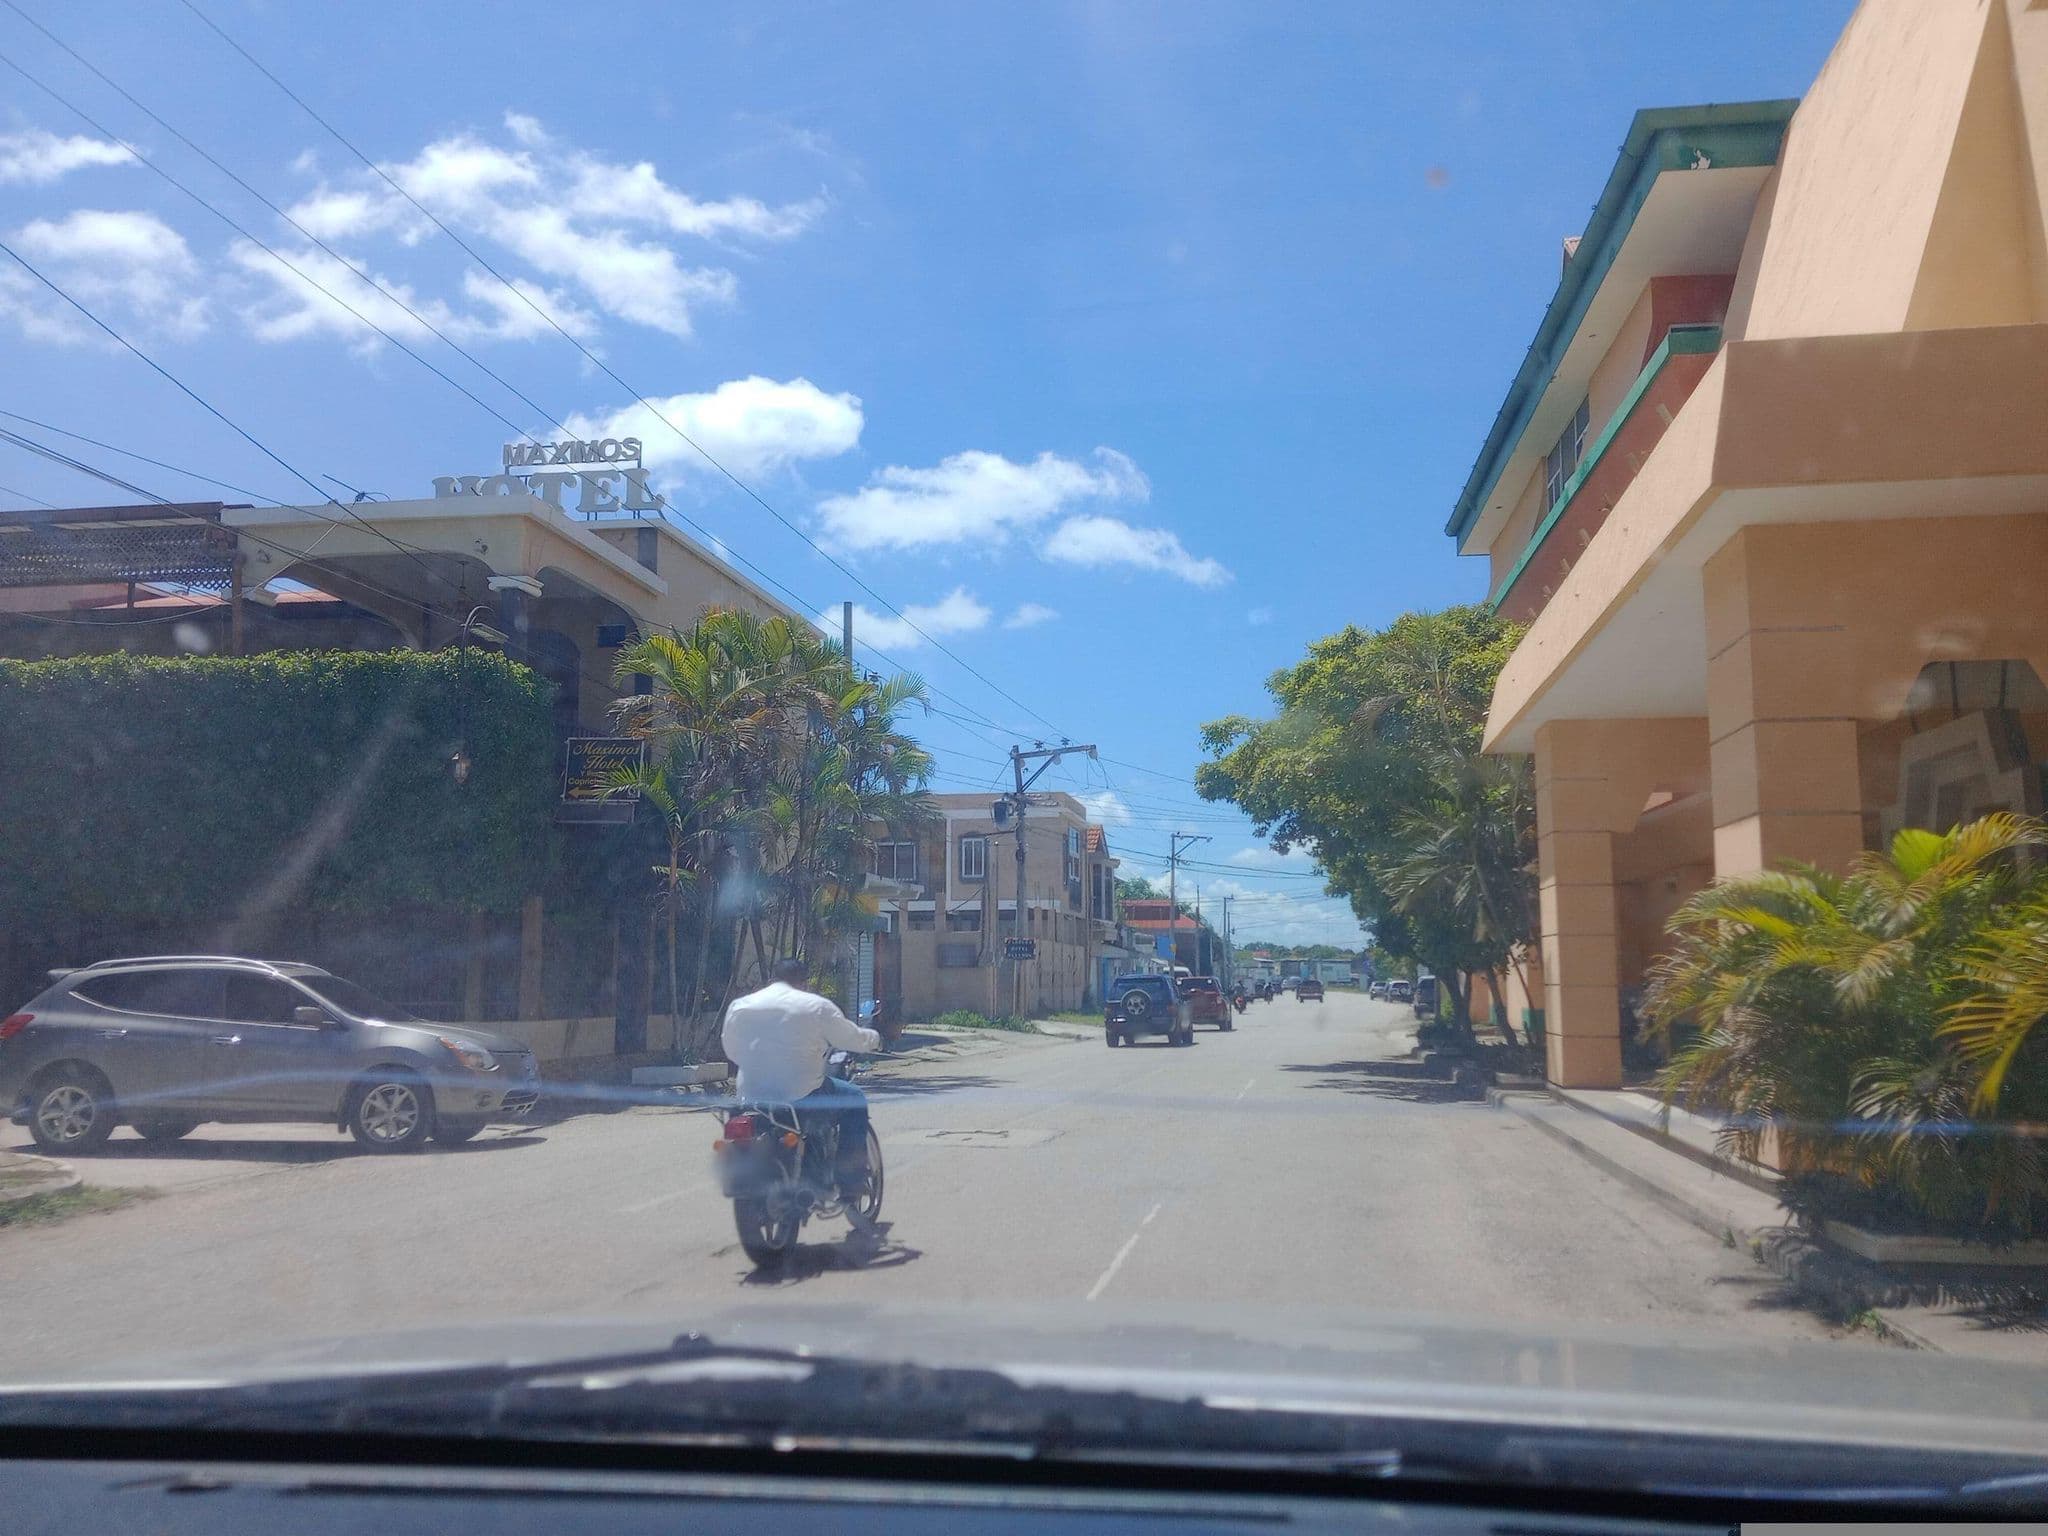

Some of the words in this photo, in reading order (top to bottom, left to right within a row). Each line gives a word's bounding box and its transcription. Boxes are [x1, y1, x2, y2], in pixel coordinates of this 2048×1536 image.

[503, 438, 641, 465] MAXIMOS
[573, 741, 640, 755] Maximos
[585, 755, 626, 769] Hotel
